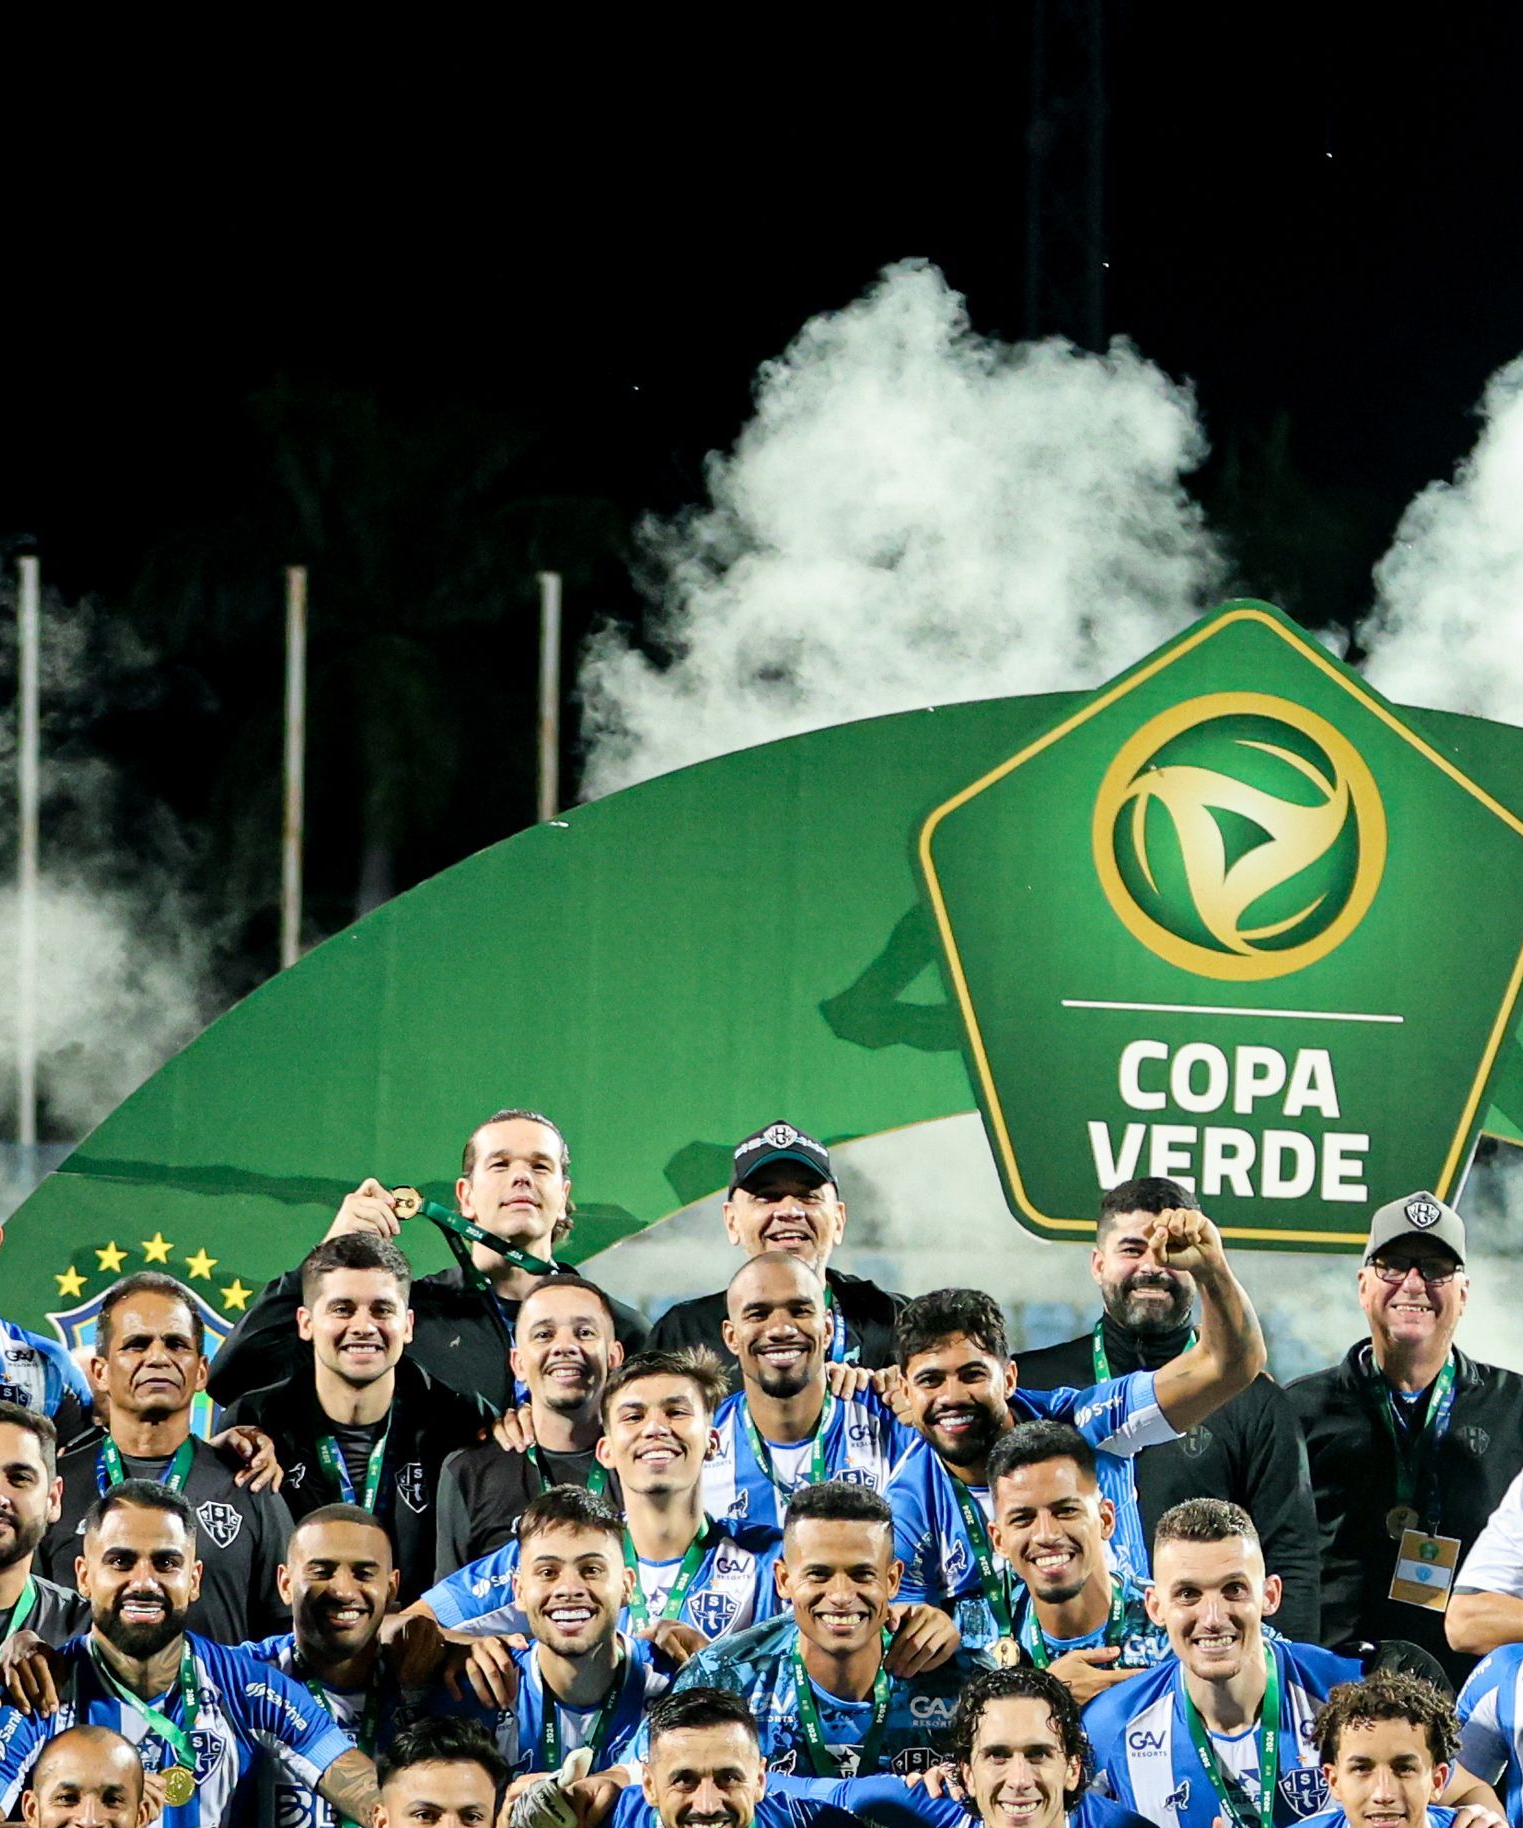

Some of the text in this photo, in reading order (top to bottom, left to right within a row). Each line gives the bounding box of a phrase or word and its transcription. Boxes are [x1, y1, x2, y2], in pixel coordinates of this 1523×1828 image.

[1119, 1039, 1340, 1119] COPA
[1087, 1120, 1370, 1202] VERDE
[813, 1439, 821, 1461] 2024
[963, 1505, 974, 1525] 2024
[717, 1556, 749, 1574] GAV
[979, 1556, 991, 1577] 2024
[676, 1573, 690, 1592] 2024
[691, 1596, 737, 1614] PSC
[1112, 1599, 1121, 1621] 2024
[795, 1664, 805, 1686] 2024
[876, 1703, 887, 1724] 2024
[912, 1719, 953, 1728] RESORT
[545, 1722, 555, 1744] 2024
[807, 1722, 818, 1744] 2024
[1129, 1730, 1167, 1750] GAV
[1265, 1731, 1275, 1753] 2024
[1198, 1746, 1212, 1769] 2024
[1262, 1790, 1272, 1813] 2024
